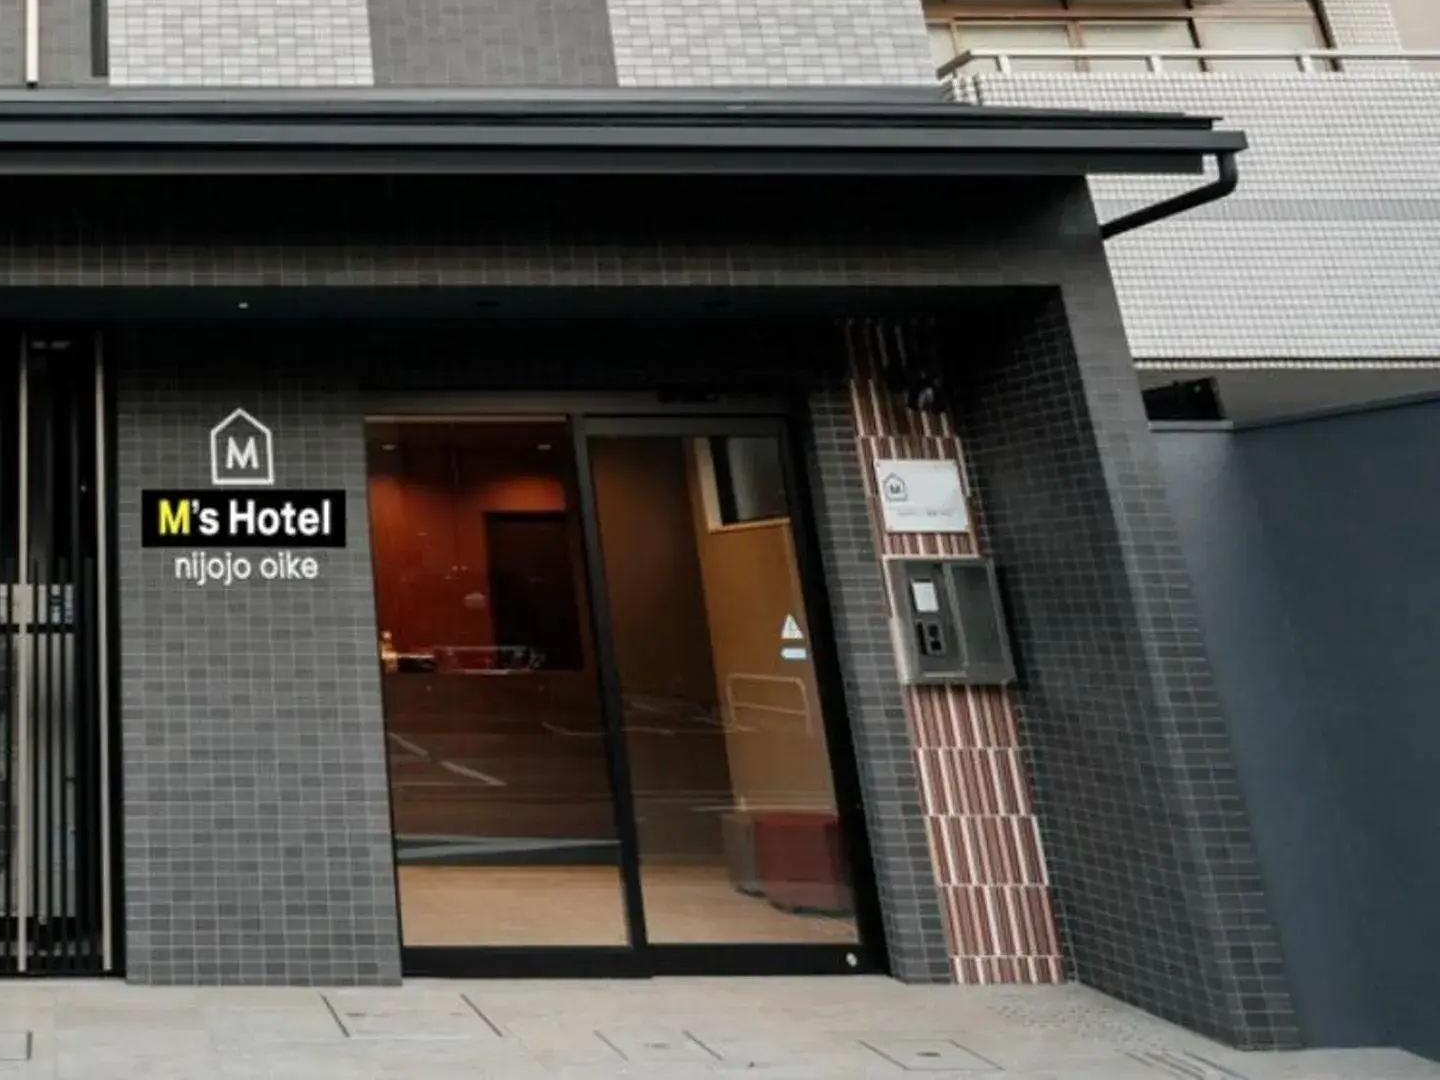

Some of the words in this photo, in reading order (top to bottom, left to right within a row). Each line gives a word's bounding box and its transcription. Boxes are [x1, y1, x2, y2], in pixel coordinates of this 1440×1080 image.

[226, 436, 259, 469] M
[159, 498, 220, 536] M's
[229, 498, 331, 536] Hotel
[174, 550, 251, 586] nijojo
[260, 551, 319, 580] oike
